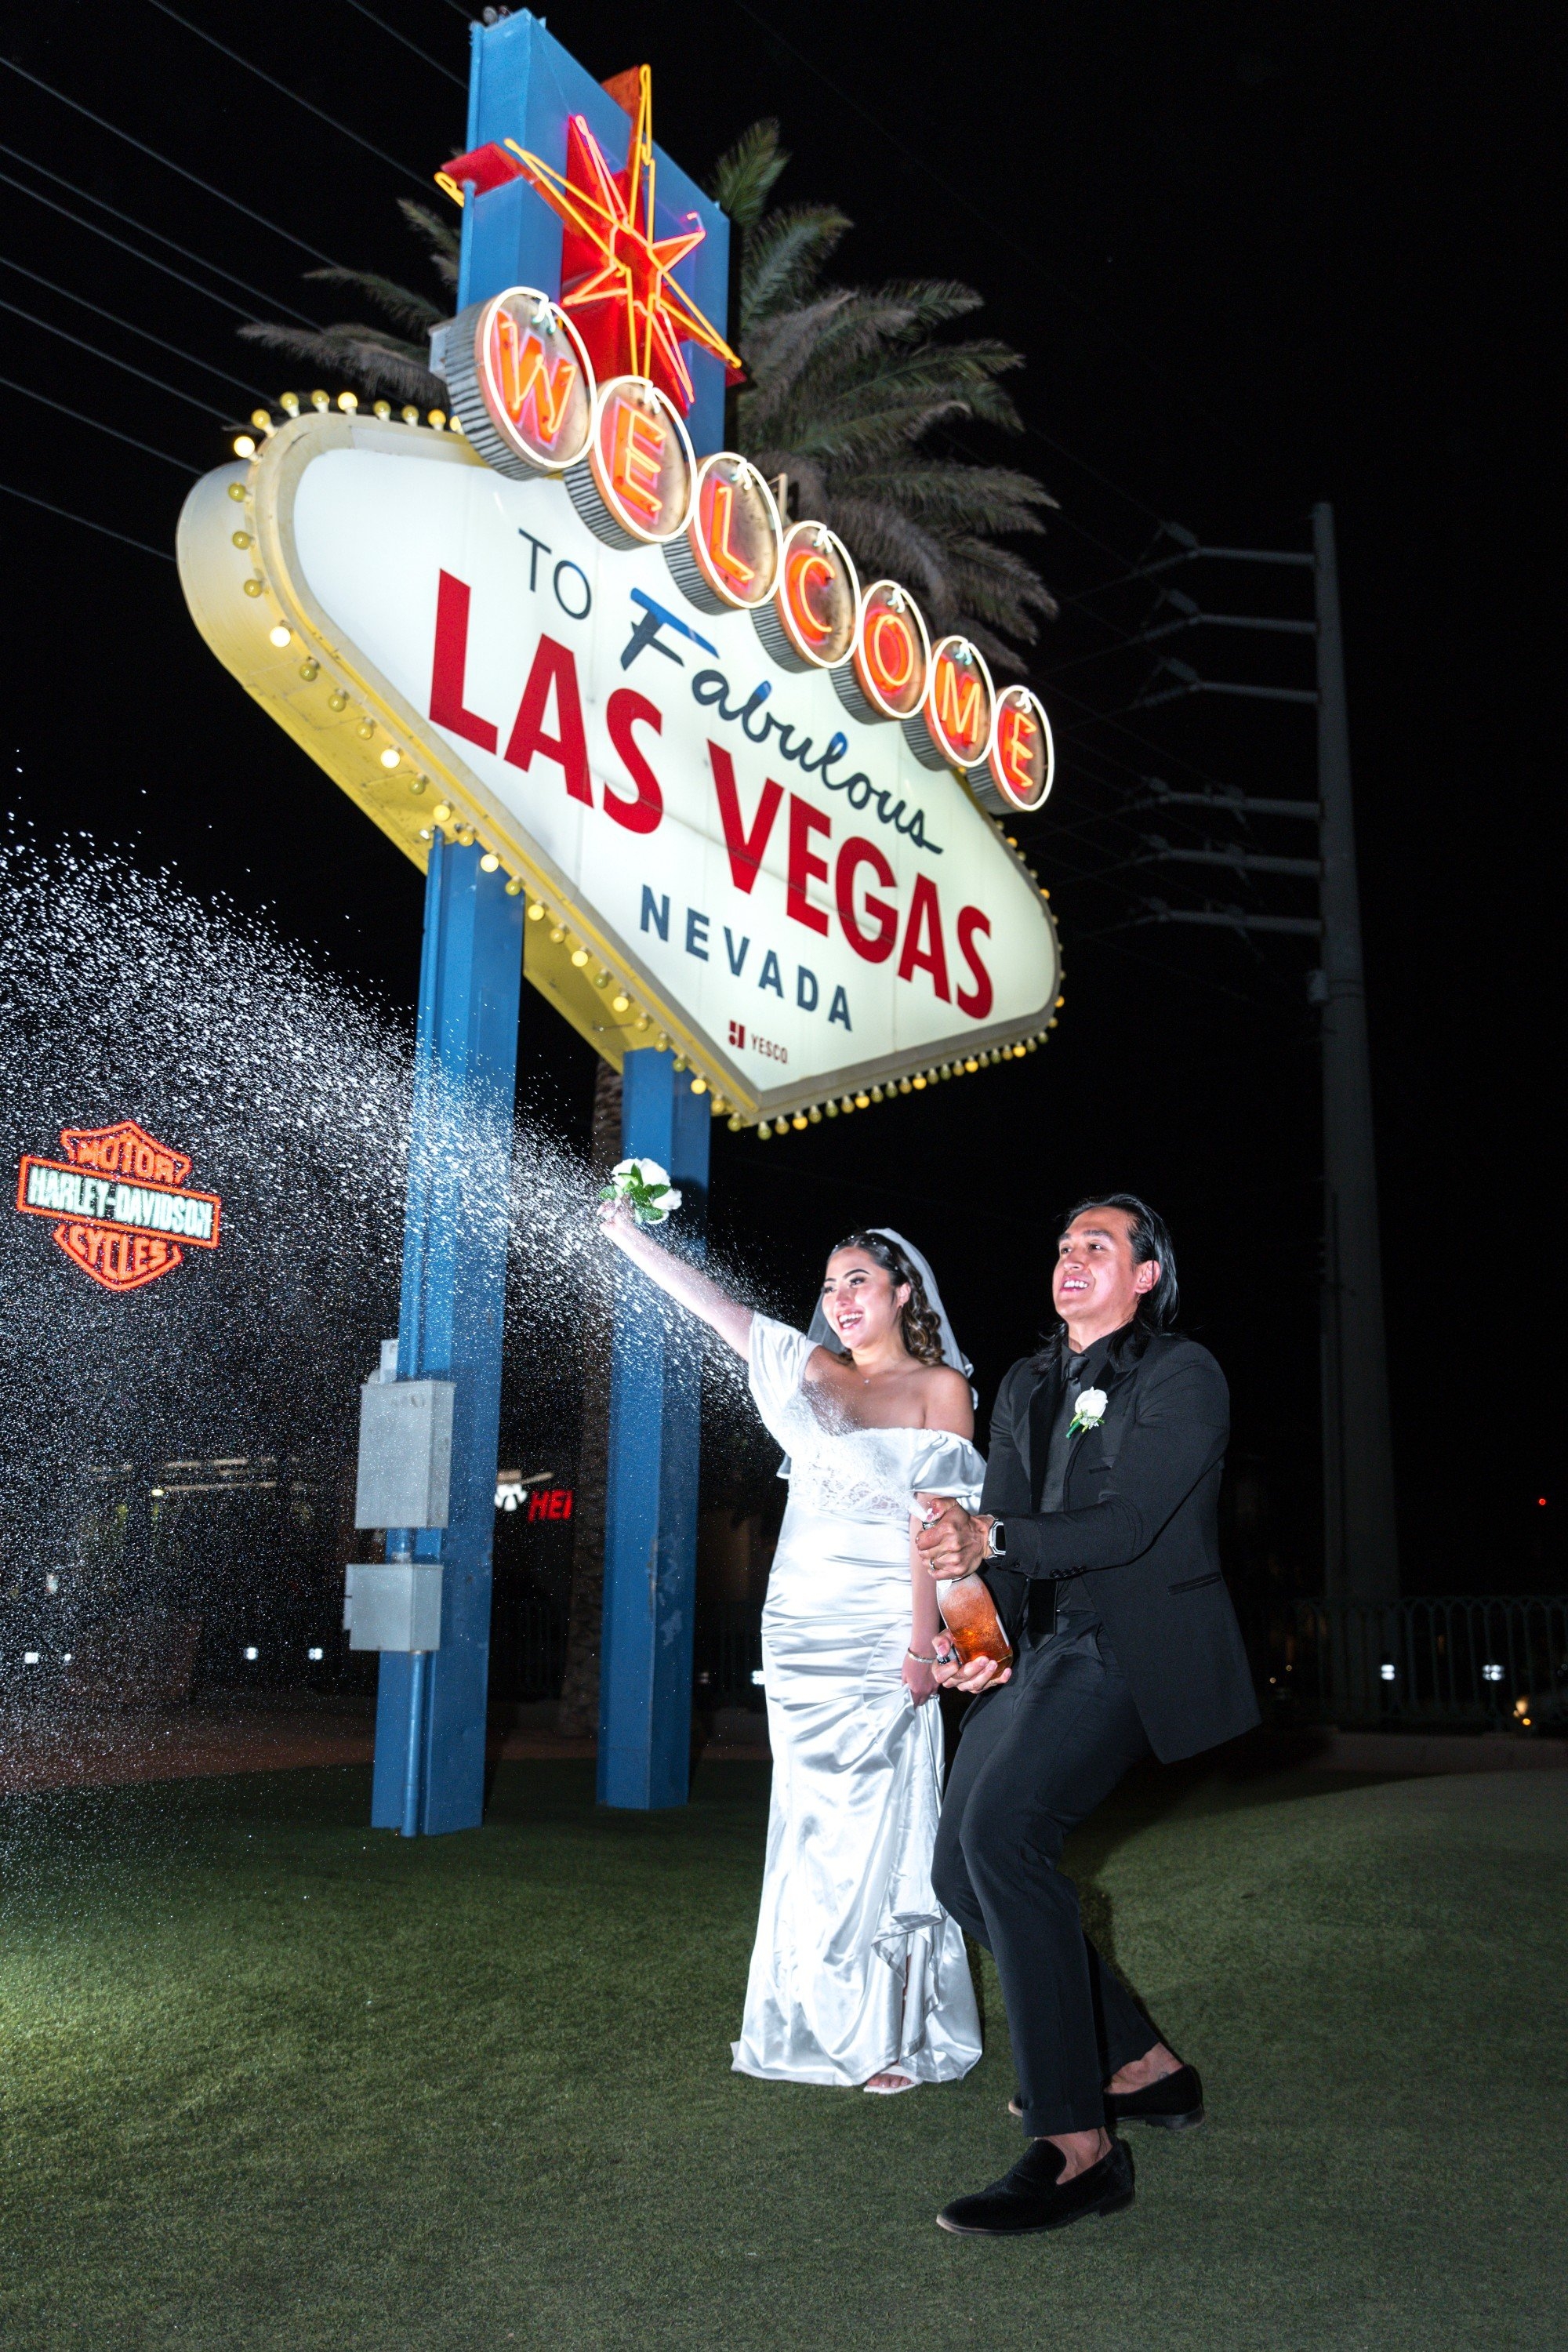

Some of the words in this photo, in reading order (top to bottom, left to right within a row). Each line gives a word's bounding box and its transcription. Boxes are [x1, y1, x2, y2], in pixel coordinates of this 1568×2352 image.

[494, 310, 1036, 792] WELCOME
[518, 528, 592, 620] TO
[620, 587, 943, 855] Fabulous
[429, 568, 664, 835] LAS
[707, 739, 994, 1020] VEGAS
[640, 884, 853, 1032] NEVADA
[750, 1033, 789, 1065] YESCO
[27, 1165, 213, 1239] HARLEY-DAVIDSON
[76, 1132, 175, 1183] MOTOR
[68, 1225, 168, 1281] CYCLES
